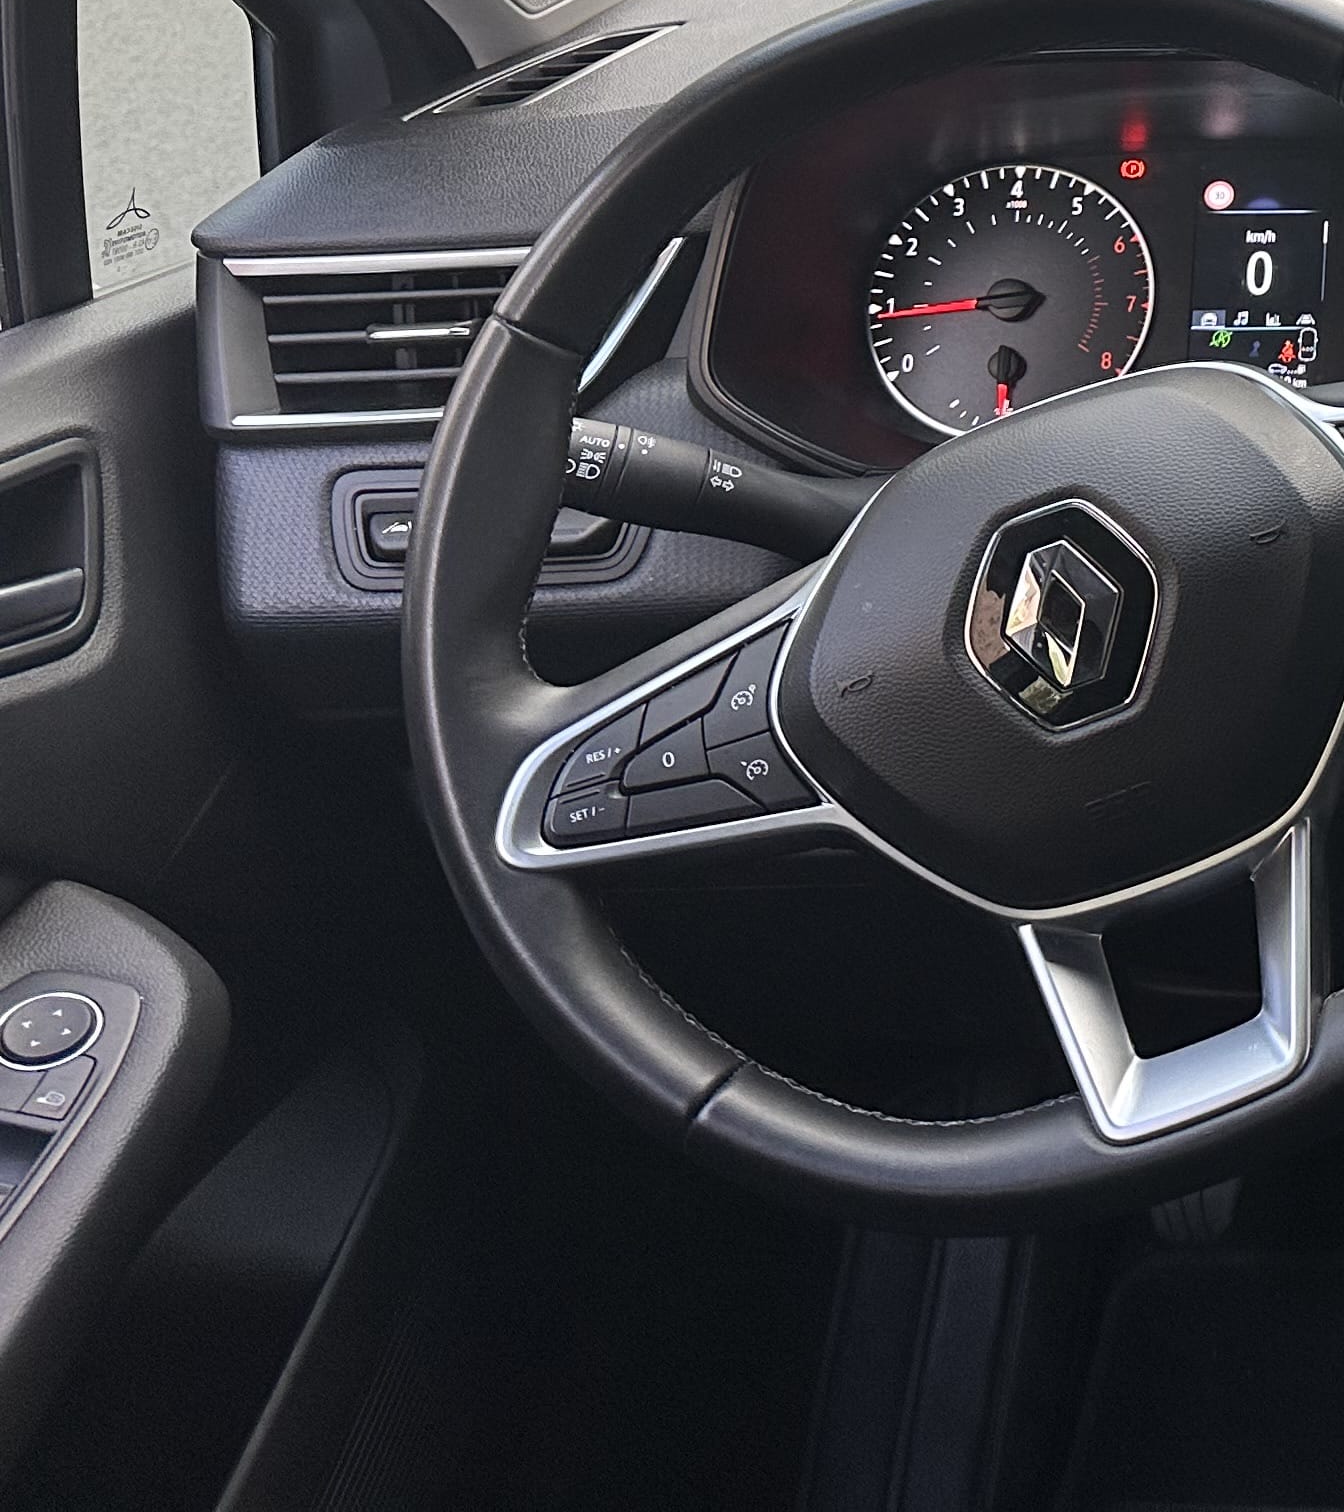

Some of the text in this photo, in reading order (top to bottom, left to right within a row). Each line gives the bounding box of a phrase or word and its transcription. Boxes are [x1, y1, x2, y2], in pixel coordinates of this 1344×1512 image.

[1010, 180, 1024, 198] 4
[953, 198, 965, 217] 3
[1071, 196, 1083, 216] 5
[1114, 236, 1126, 253] 6
[1246, 229, 1277, 244] km/h
[906, 238, 918, 257] 2
[1246, 251, 1273, 296] 0
[886, 298, 895, 314] 1
[1126, 295, 1136, 311] 7
[902, 354, 914, 372] 0
[1101, 352, 1112, 370] 8
[579, 435, 611, 448] AUTO
[585, 749, 606, 764] RES
[569, 808, 589, 823] SET
